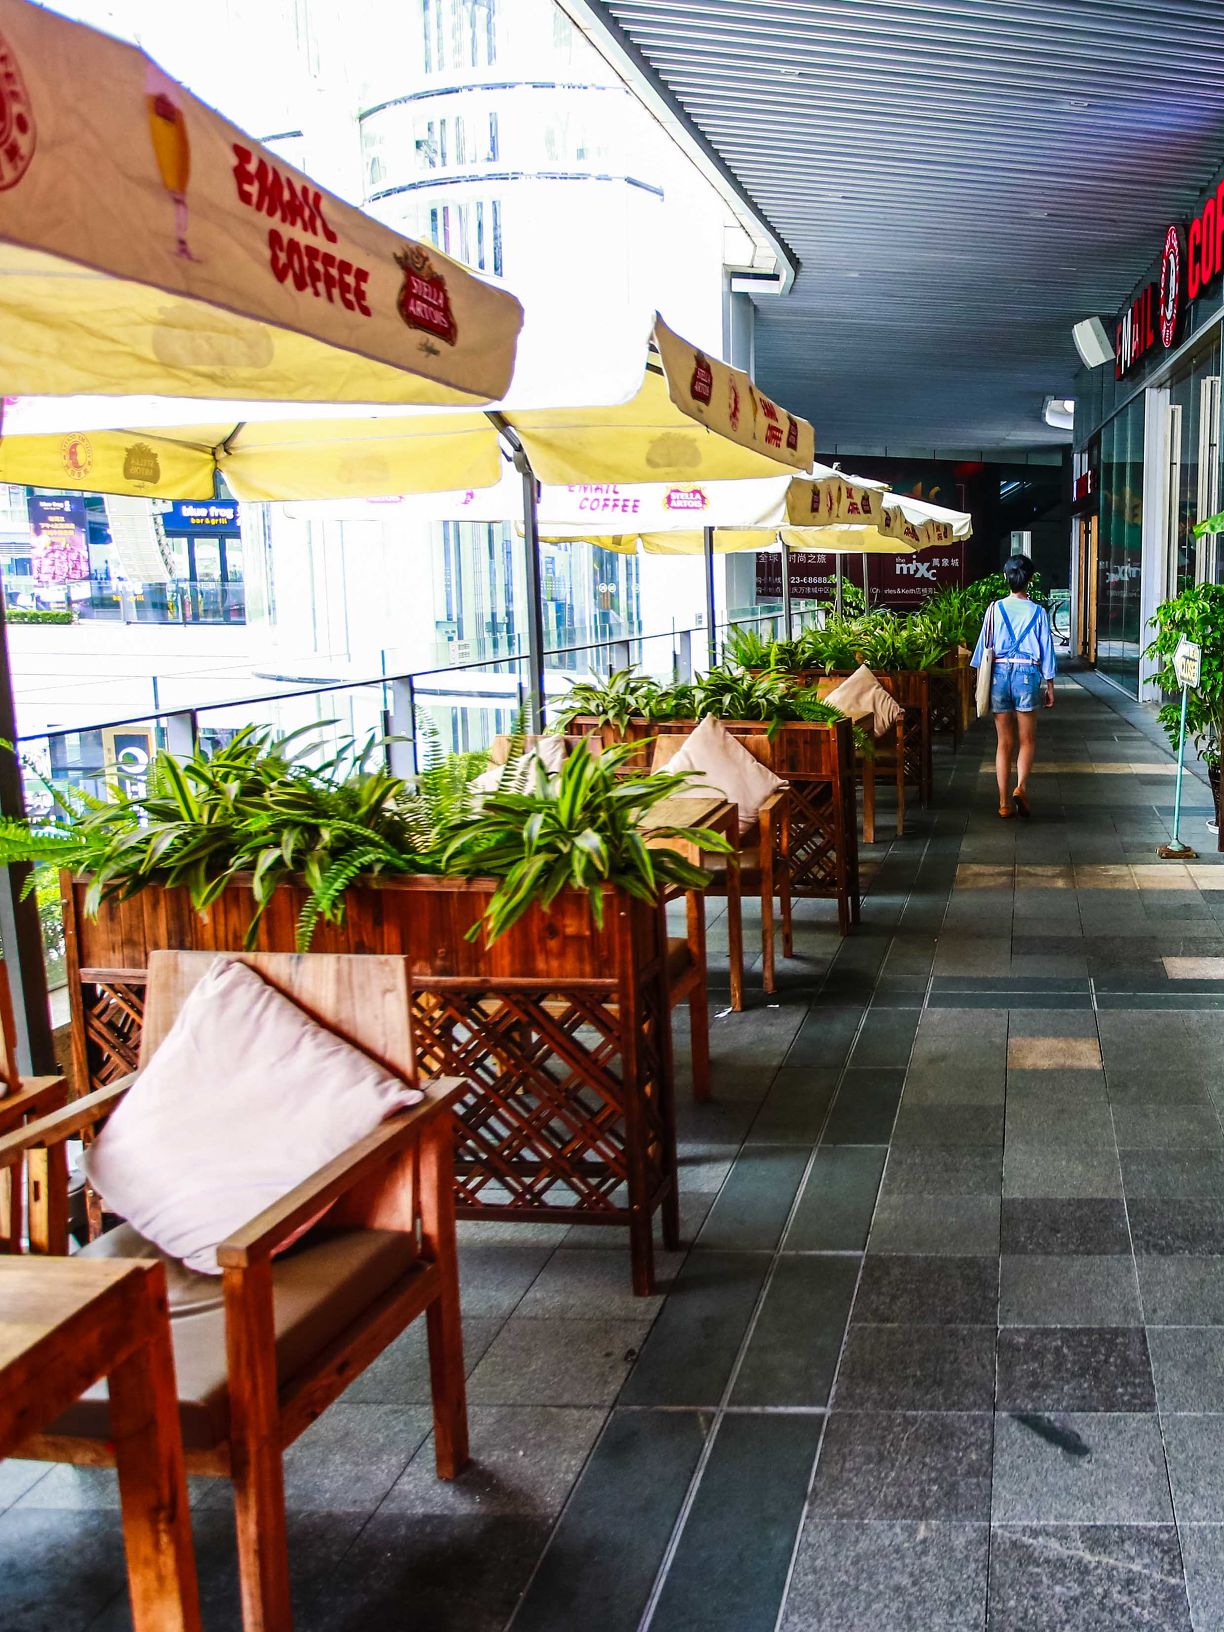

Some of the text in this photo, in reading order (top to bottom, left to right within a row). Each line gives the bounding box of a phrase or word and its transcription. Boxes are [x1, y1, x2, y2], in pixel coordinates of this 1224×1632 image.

[233, 143, 338, 244] EMAIL
[268, 228, 373, 318] COFFEE
[410, 275, 445, 309] STELLA
[408, 297, 449, 329] ARTOIS
[578, 498, 641, 513] COFFEE
[670, 492, 702, 500] STELLA
[670, 500, 703, 508] ARTOIS
[181, 505, 208, 517] blue
[209, 506, 235, 520] frog
